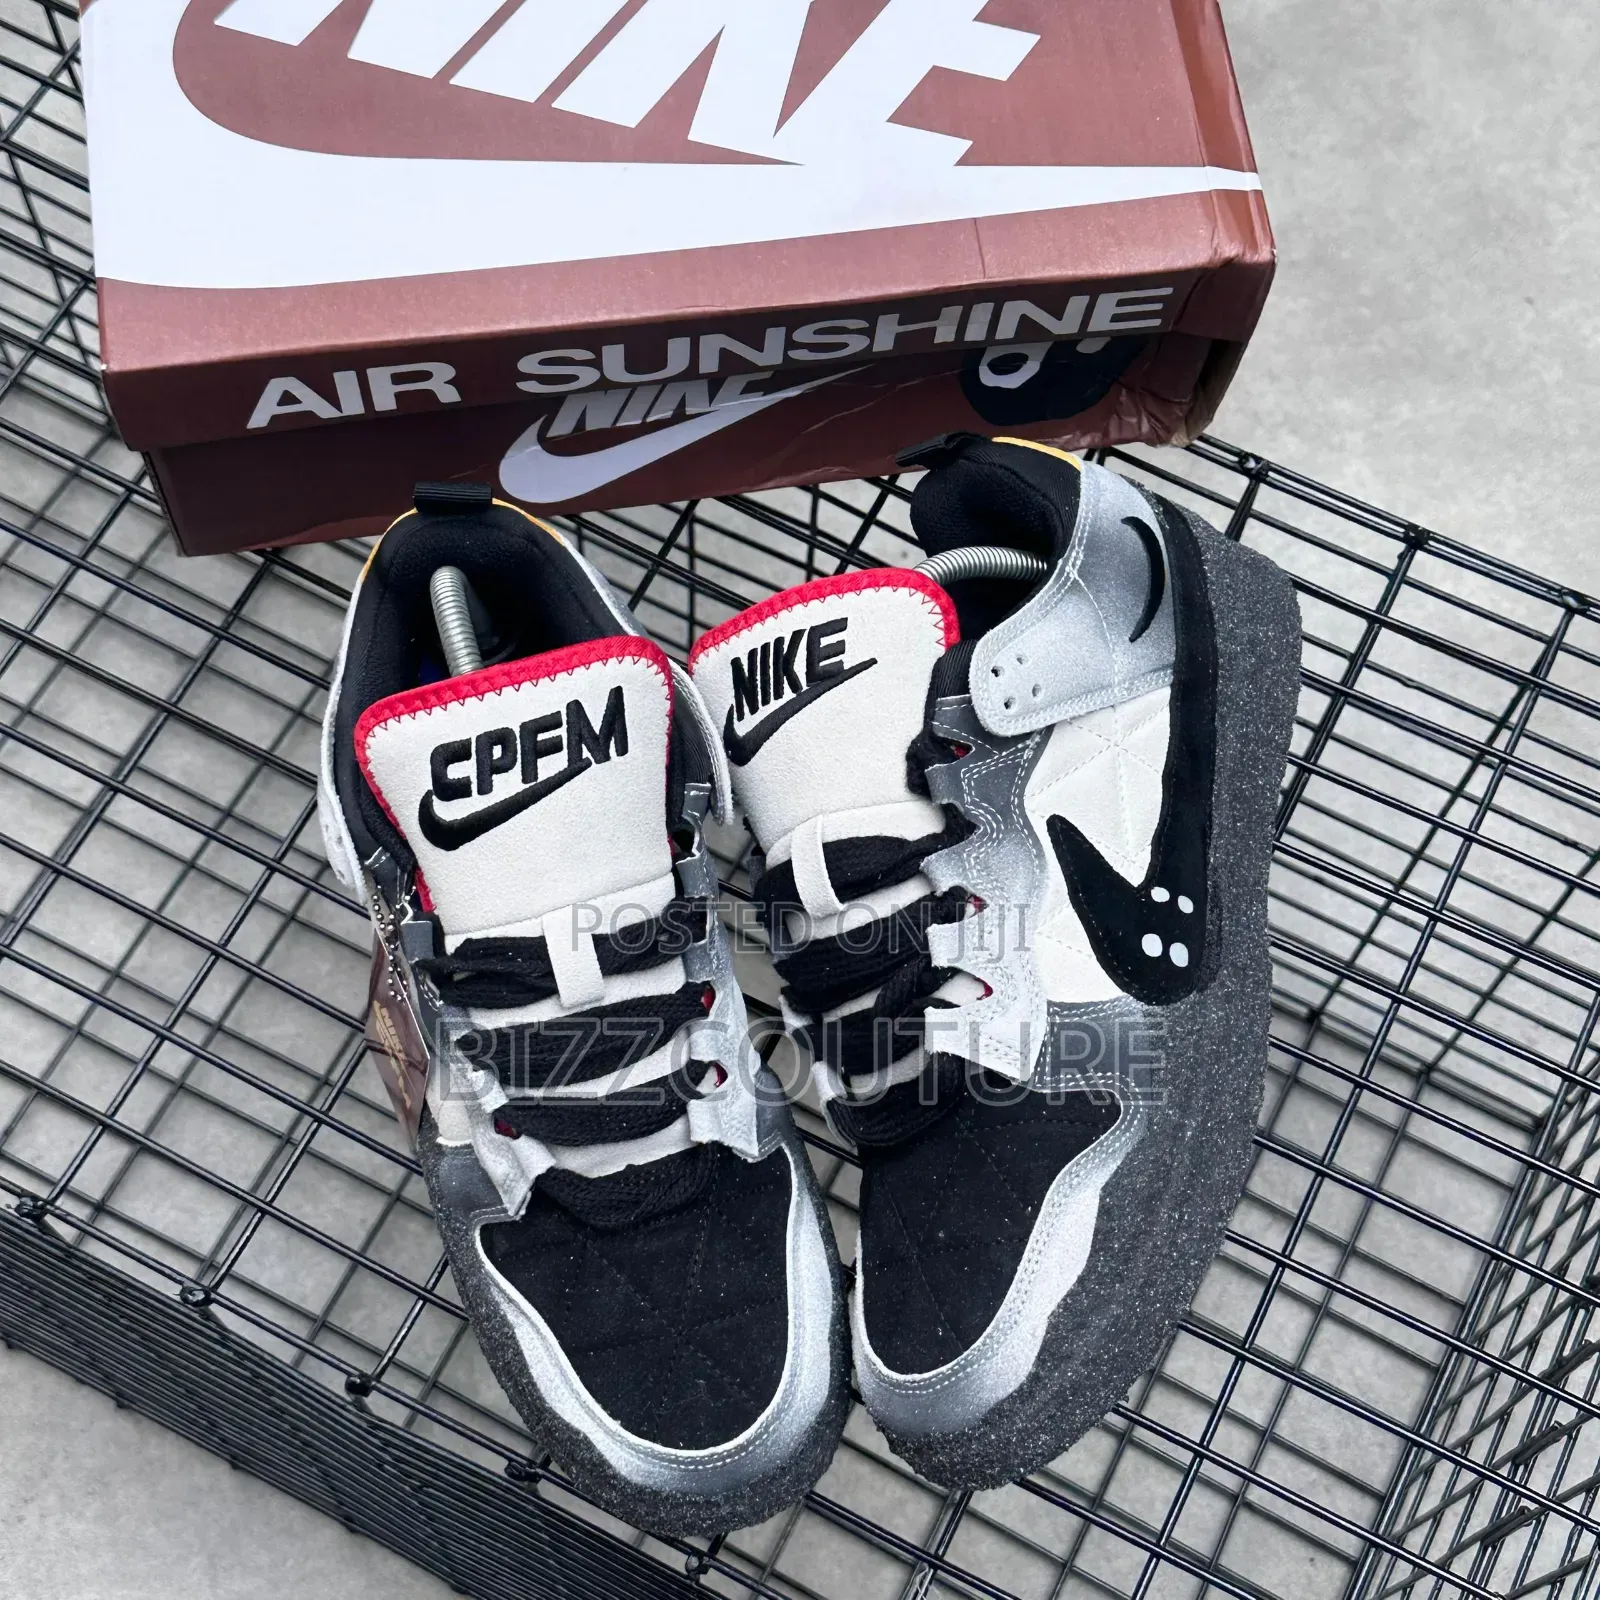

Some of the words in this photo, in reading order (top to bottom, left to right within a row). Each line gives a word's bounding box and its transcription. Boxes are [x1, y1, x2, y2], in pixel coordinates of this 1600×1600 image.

[246, 361, 462, 430] AIR
[516, 287, 1173, 394] SUNSHINE
[730, 616, 849, 722] NIKE
[430, 685, 629, 801] CPFM
